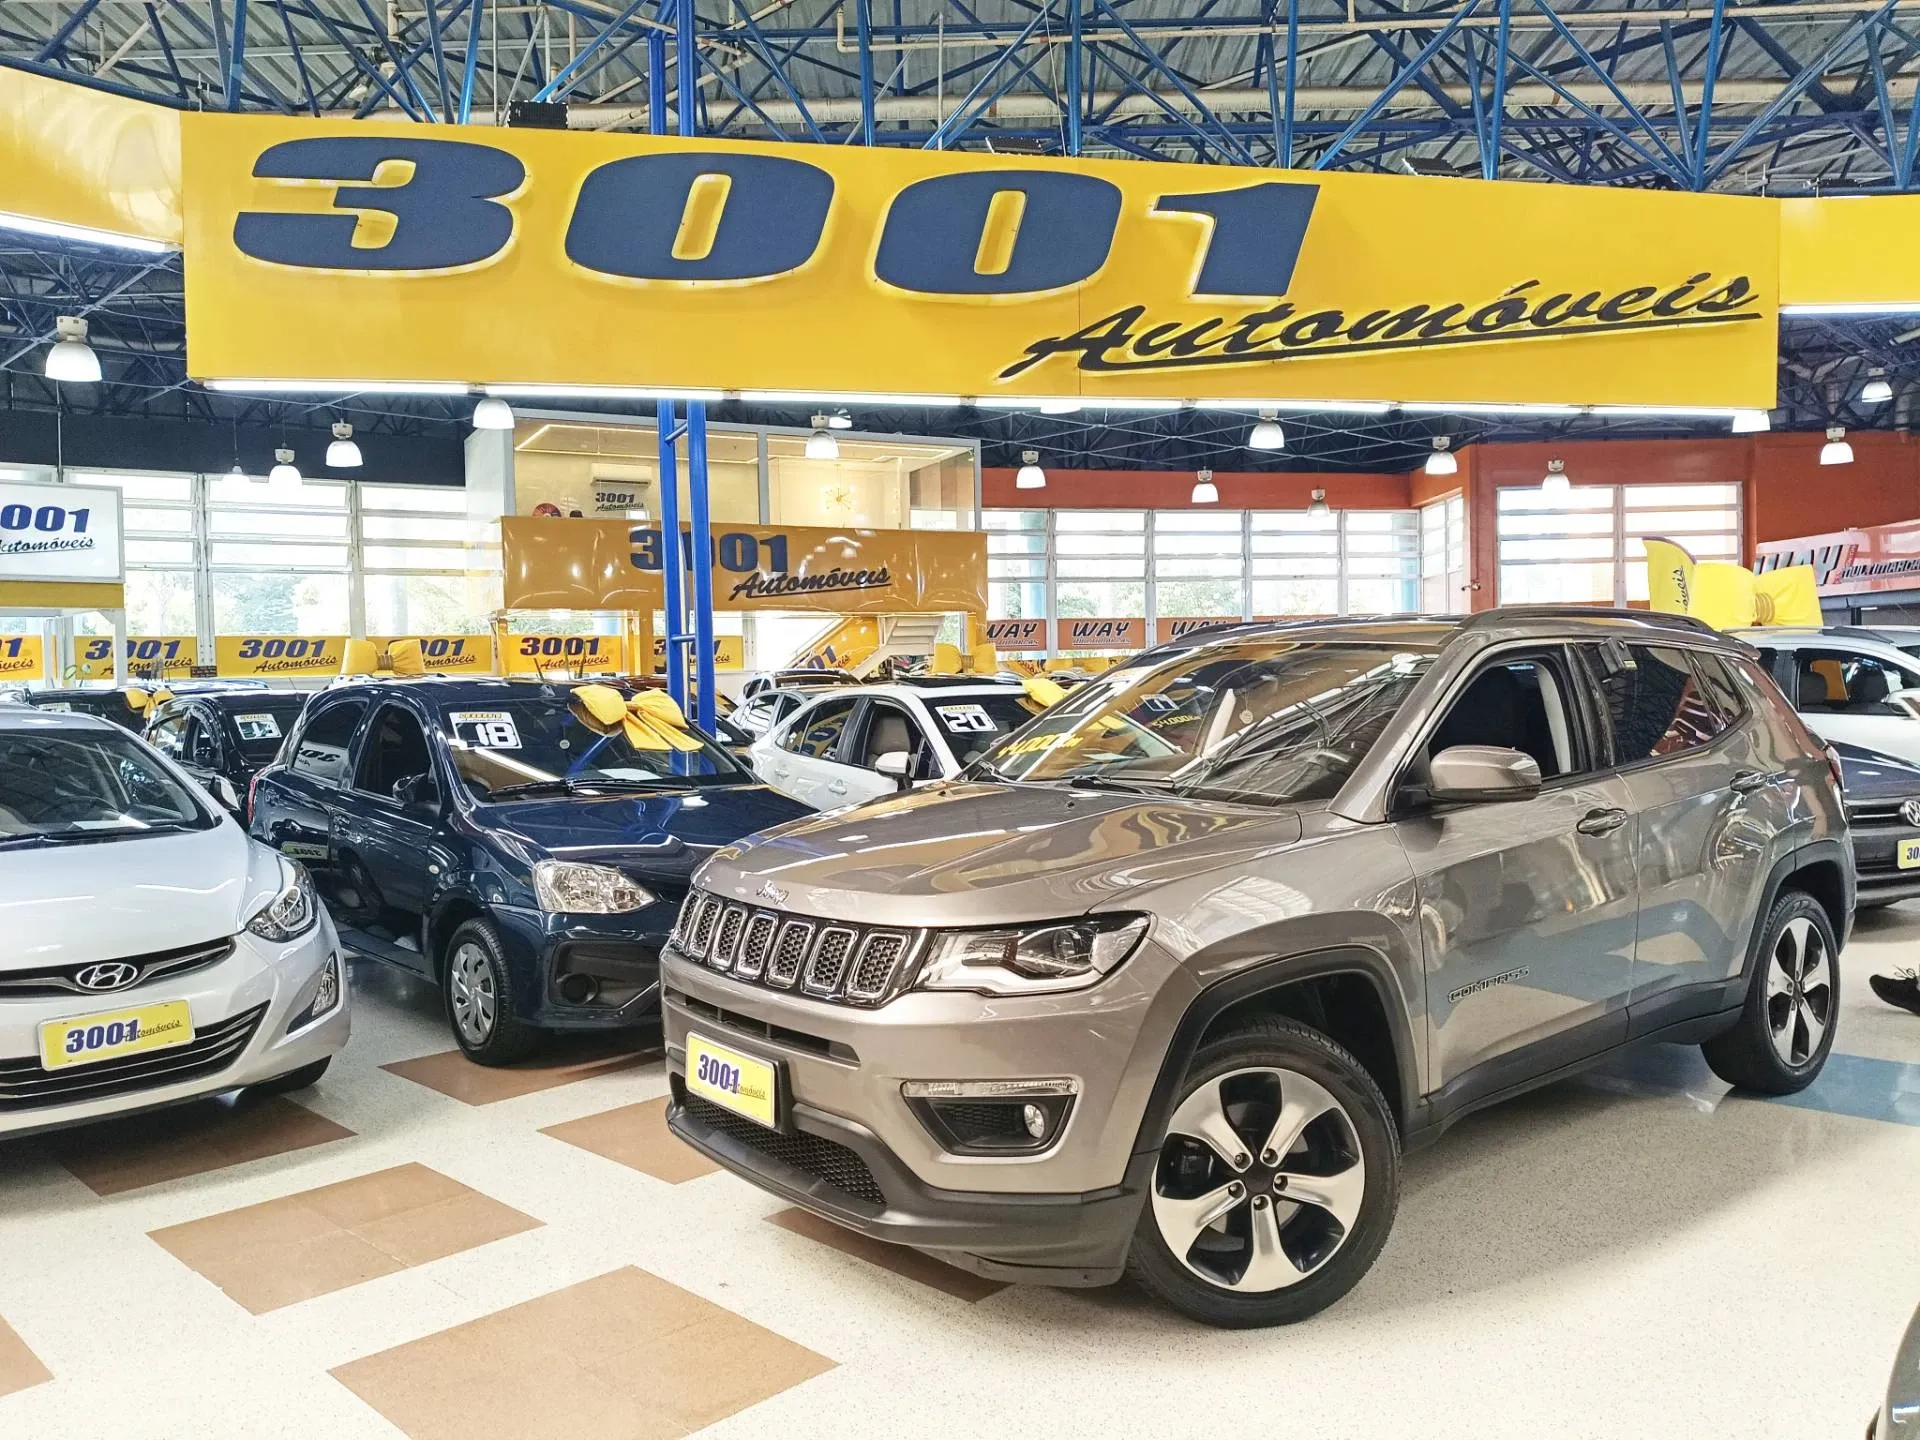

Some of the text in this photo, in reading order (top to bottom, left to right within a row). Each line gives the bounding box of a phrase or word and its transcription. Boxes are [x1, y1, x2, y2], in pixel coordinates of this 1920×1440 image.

[233, 136, 1320, 296] 3001
[998, 273, 1762, 381] Automóveis
[595, 492, 635, 503] 3001
[0, 536, 96, 555] utomóveis
[729, 567, 892, 601] Automóveis
[1072, 622, 1130, 637] WAY
[239, 639, 327, 658] 3001
[519, 636, 600, 656] 3001
[252, 655, 338, 673] Automóveis
[945, 713, 994, 730] 20
[475, 723, 518, 746] 18
[66, 1018, 139, 1054] 3001
[698, 1053, 740, 1095] 3001
